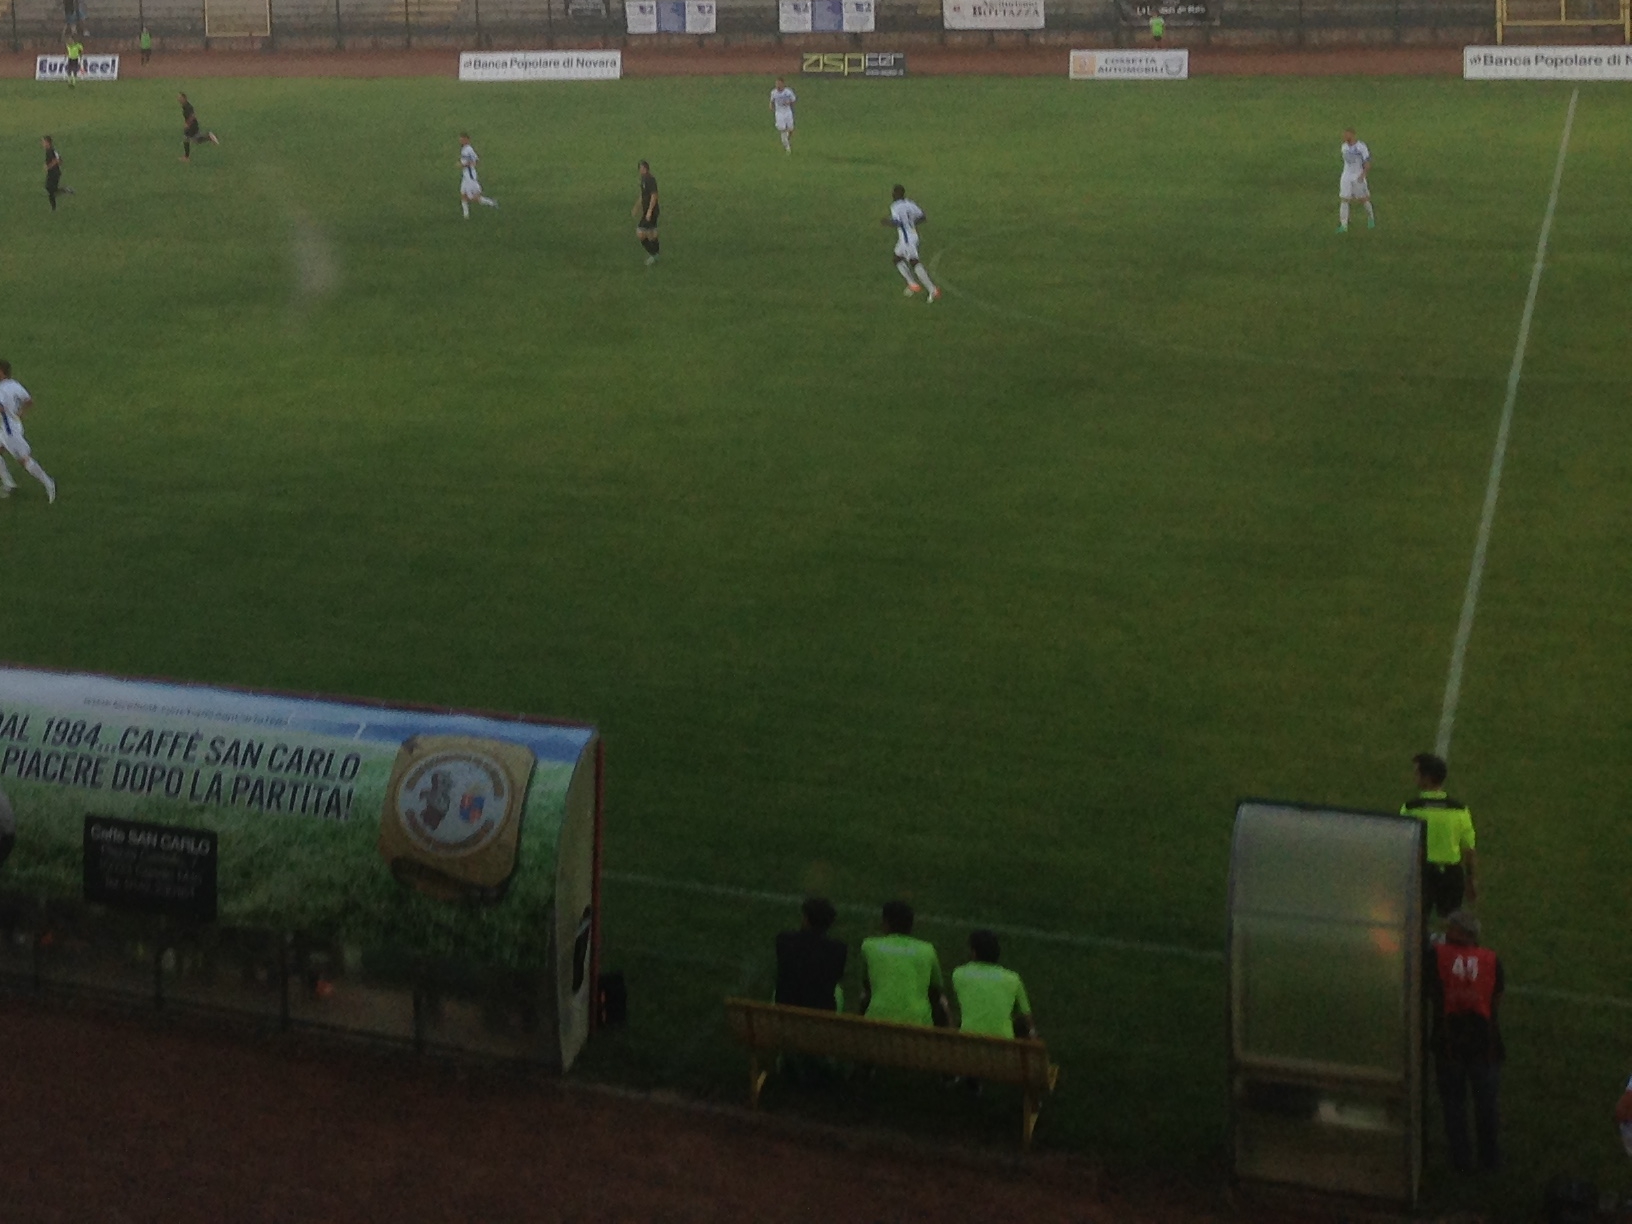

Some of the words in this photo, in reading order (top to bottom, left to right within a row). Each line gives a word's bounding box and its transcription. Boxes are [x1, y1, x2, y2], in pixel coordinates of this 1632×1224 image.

[473, 58, 507, 69] Banca
[510, 56, 560, 71] Popolare
[576, 57, 617, 68] Novara
[1483, 54, 1531, 66] Banca
[1534, 53, 1603, 68] Popolare
[1607, 53, 1621, 66] di
[205, 734, 264, 772] SAN
[267, 742, 362, 785] CARLO
[0, 744, 109, 790] PIACERE
[111, 758, 184, 799] DOPO
[189, 767, 224, 806] LA
[229, 771, 355, 822] PARTITA!
[127, 828, 158, 849] SAN
[160, 832, 211, 857] CARLO
